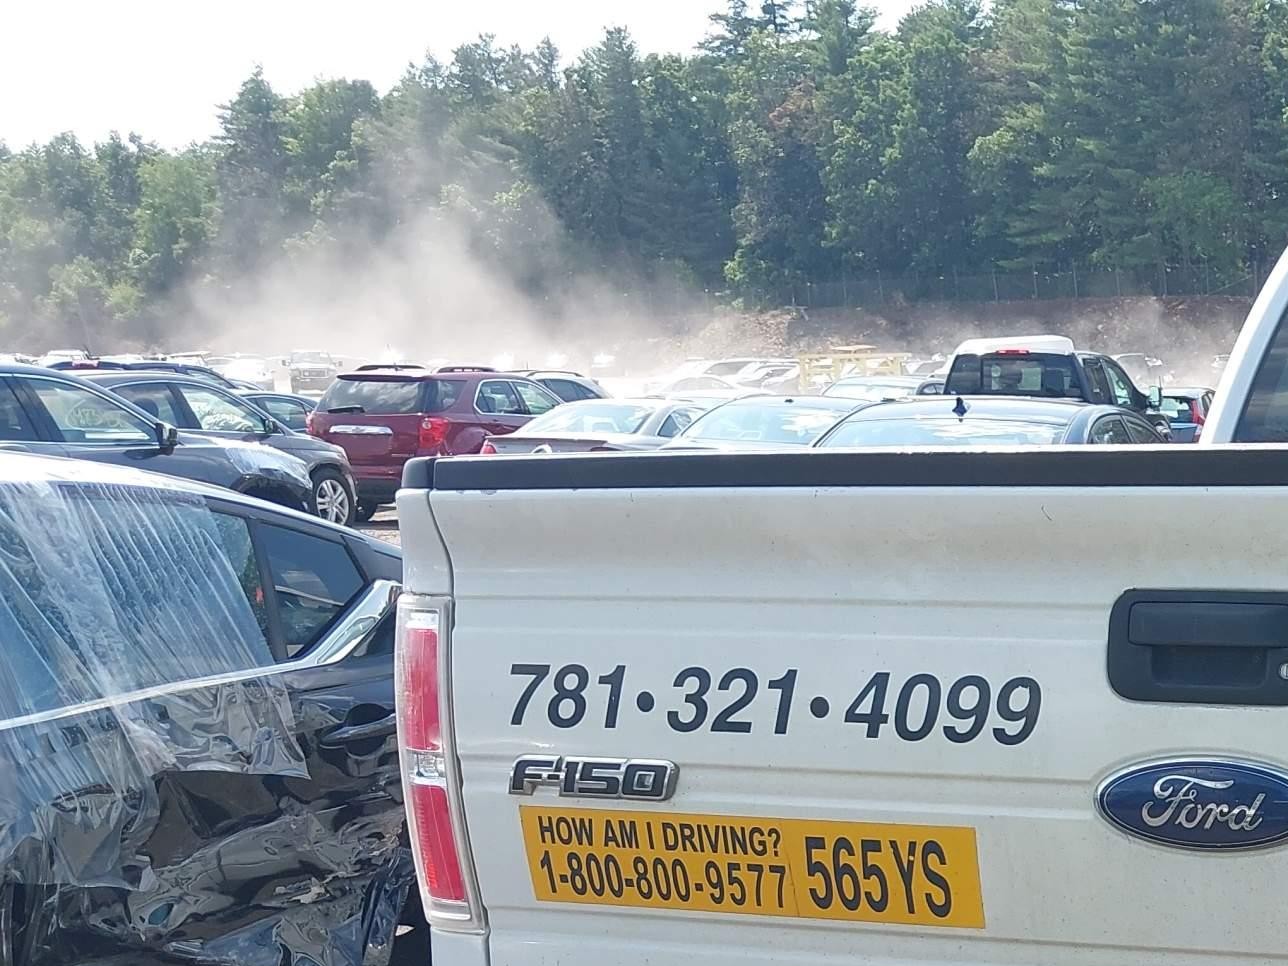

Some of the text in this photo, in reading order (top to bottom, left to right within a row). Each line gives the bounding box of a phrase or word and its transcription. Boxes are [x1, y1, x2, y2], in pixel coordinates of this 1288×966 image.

[508, 755, 681, 801] F-150
[1141, 775, 1266, 832] Ford
[537, 815, 781, 857] HOW AM I DRIVING?
[539, 850, 786, 908] 1-800-800-9577
[804, 836, 953, 919] 565YS
